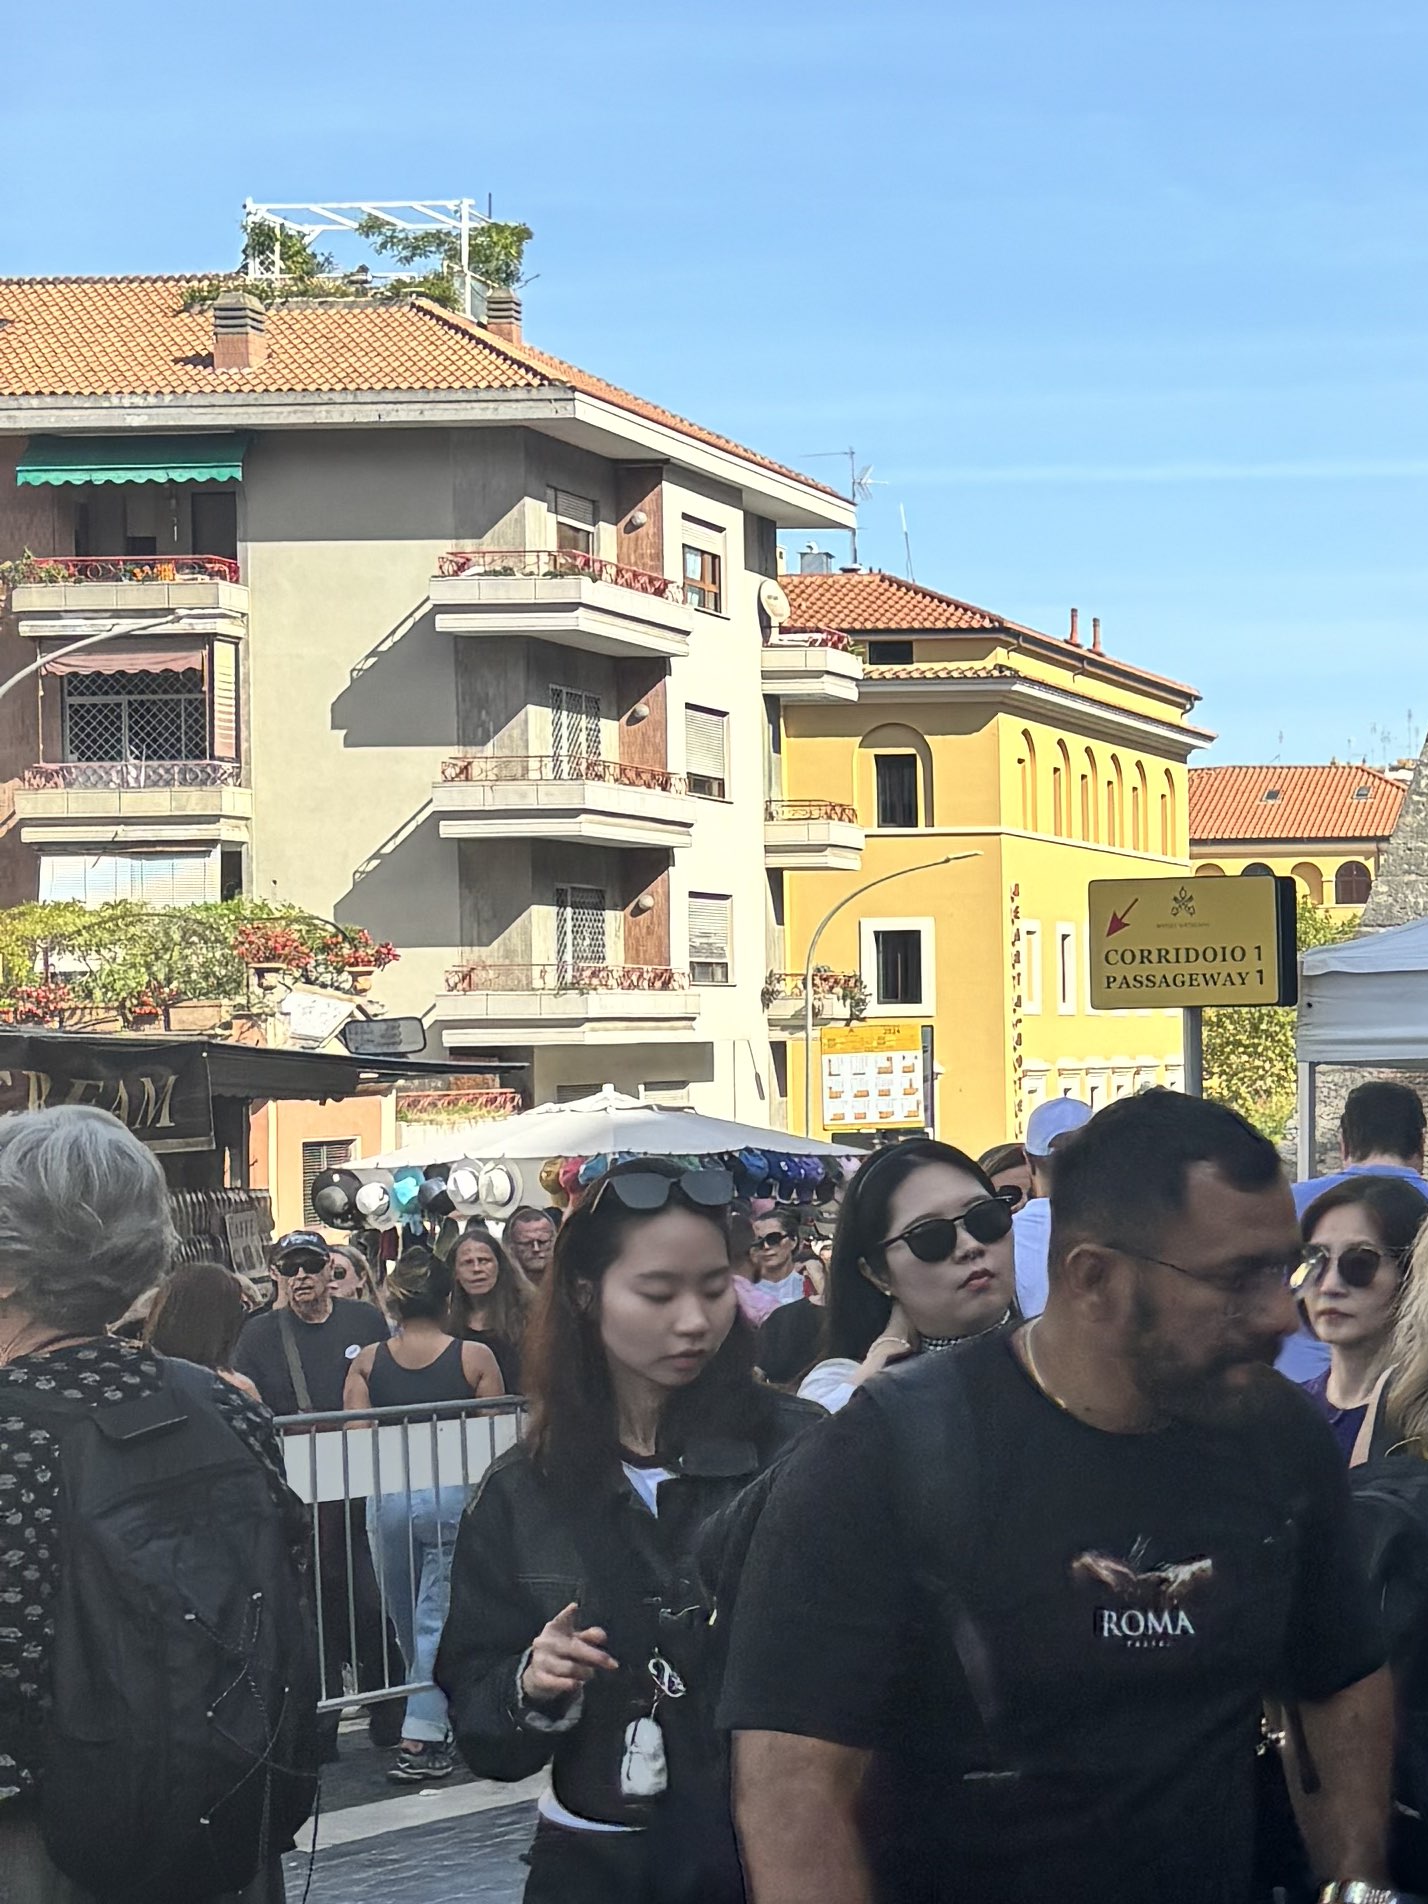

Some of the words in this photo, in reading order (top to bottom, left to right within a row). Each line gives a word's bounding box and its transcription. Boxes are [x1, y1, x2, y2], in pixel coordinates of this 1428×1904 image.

[1104, 945, 1247, 966] CORRIDOIO
[1254, 945, 1262, 962] 1
[1104, 970, 1250, 990] PASSAGEWAY
[1256, 969, 1264, 986] 1
[1102, 1609, 1196, 1637] ROMA
